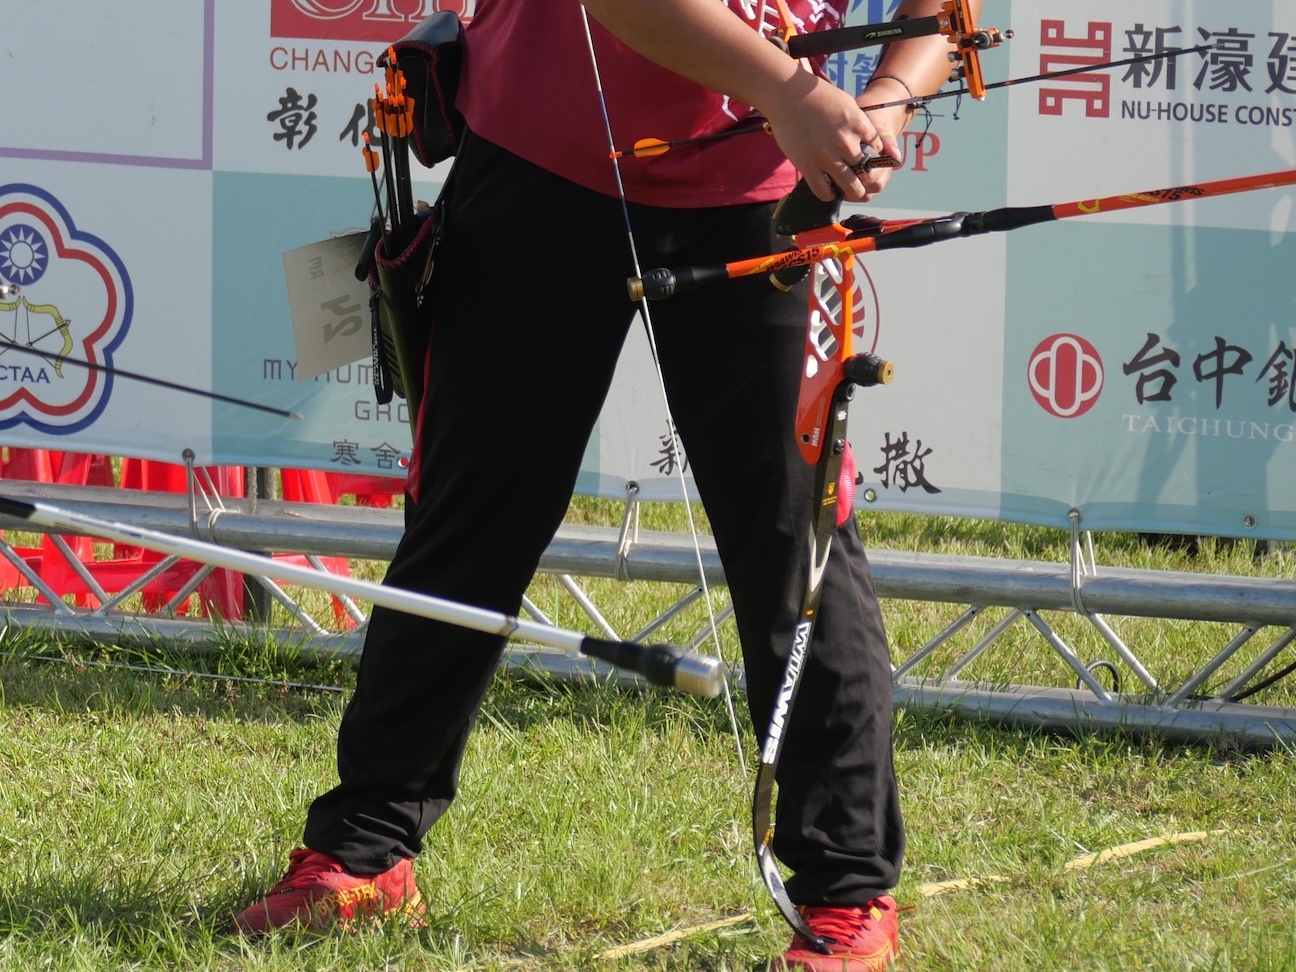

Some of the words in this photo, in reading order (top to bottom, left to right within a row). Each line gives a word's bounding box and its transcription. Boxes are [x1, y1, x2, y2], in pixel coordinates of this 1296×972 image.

[269, 46, 376, 75] CHANG
[1121, 100, 1229, 124] NU-HOUSE
[1121, 414, 1296, 443] TAICHUNG
